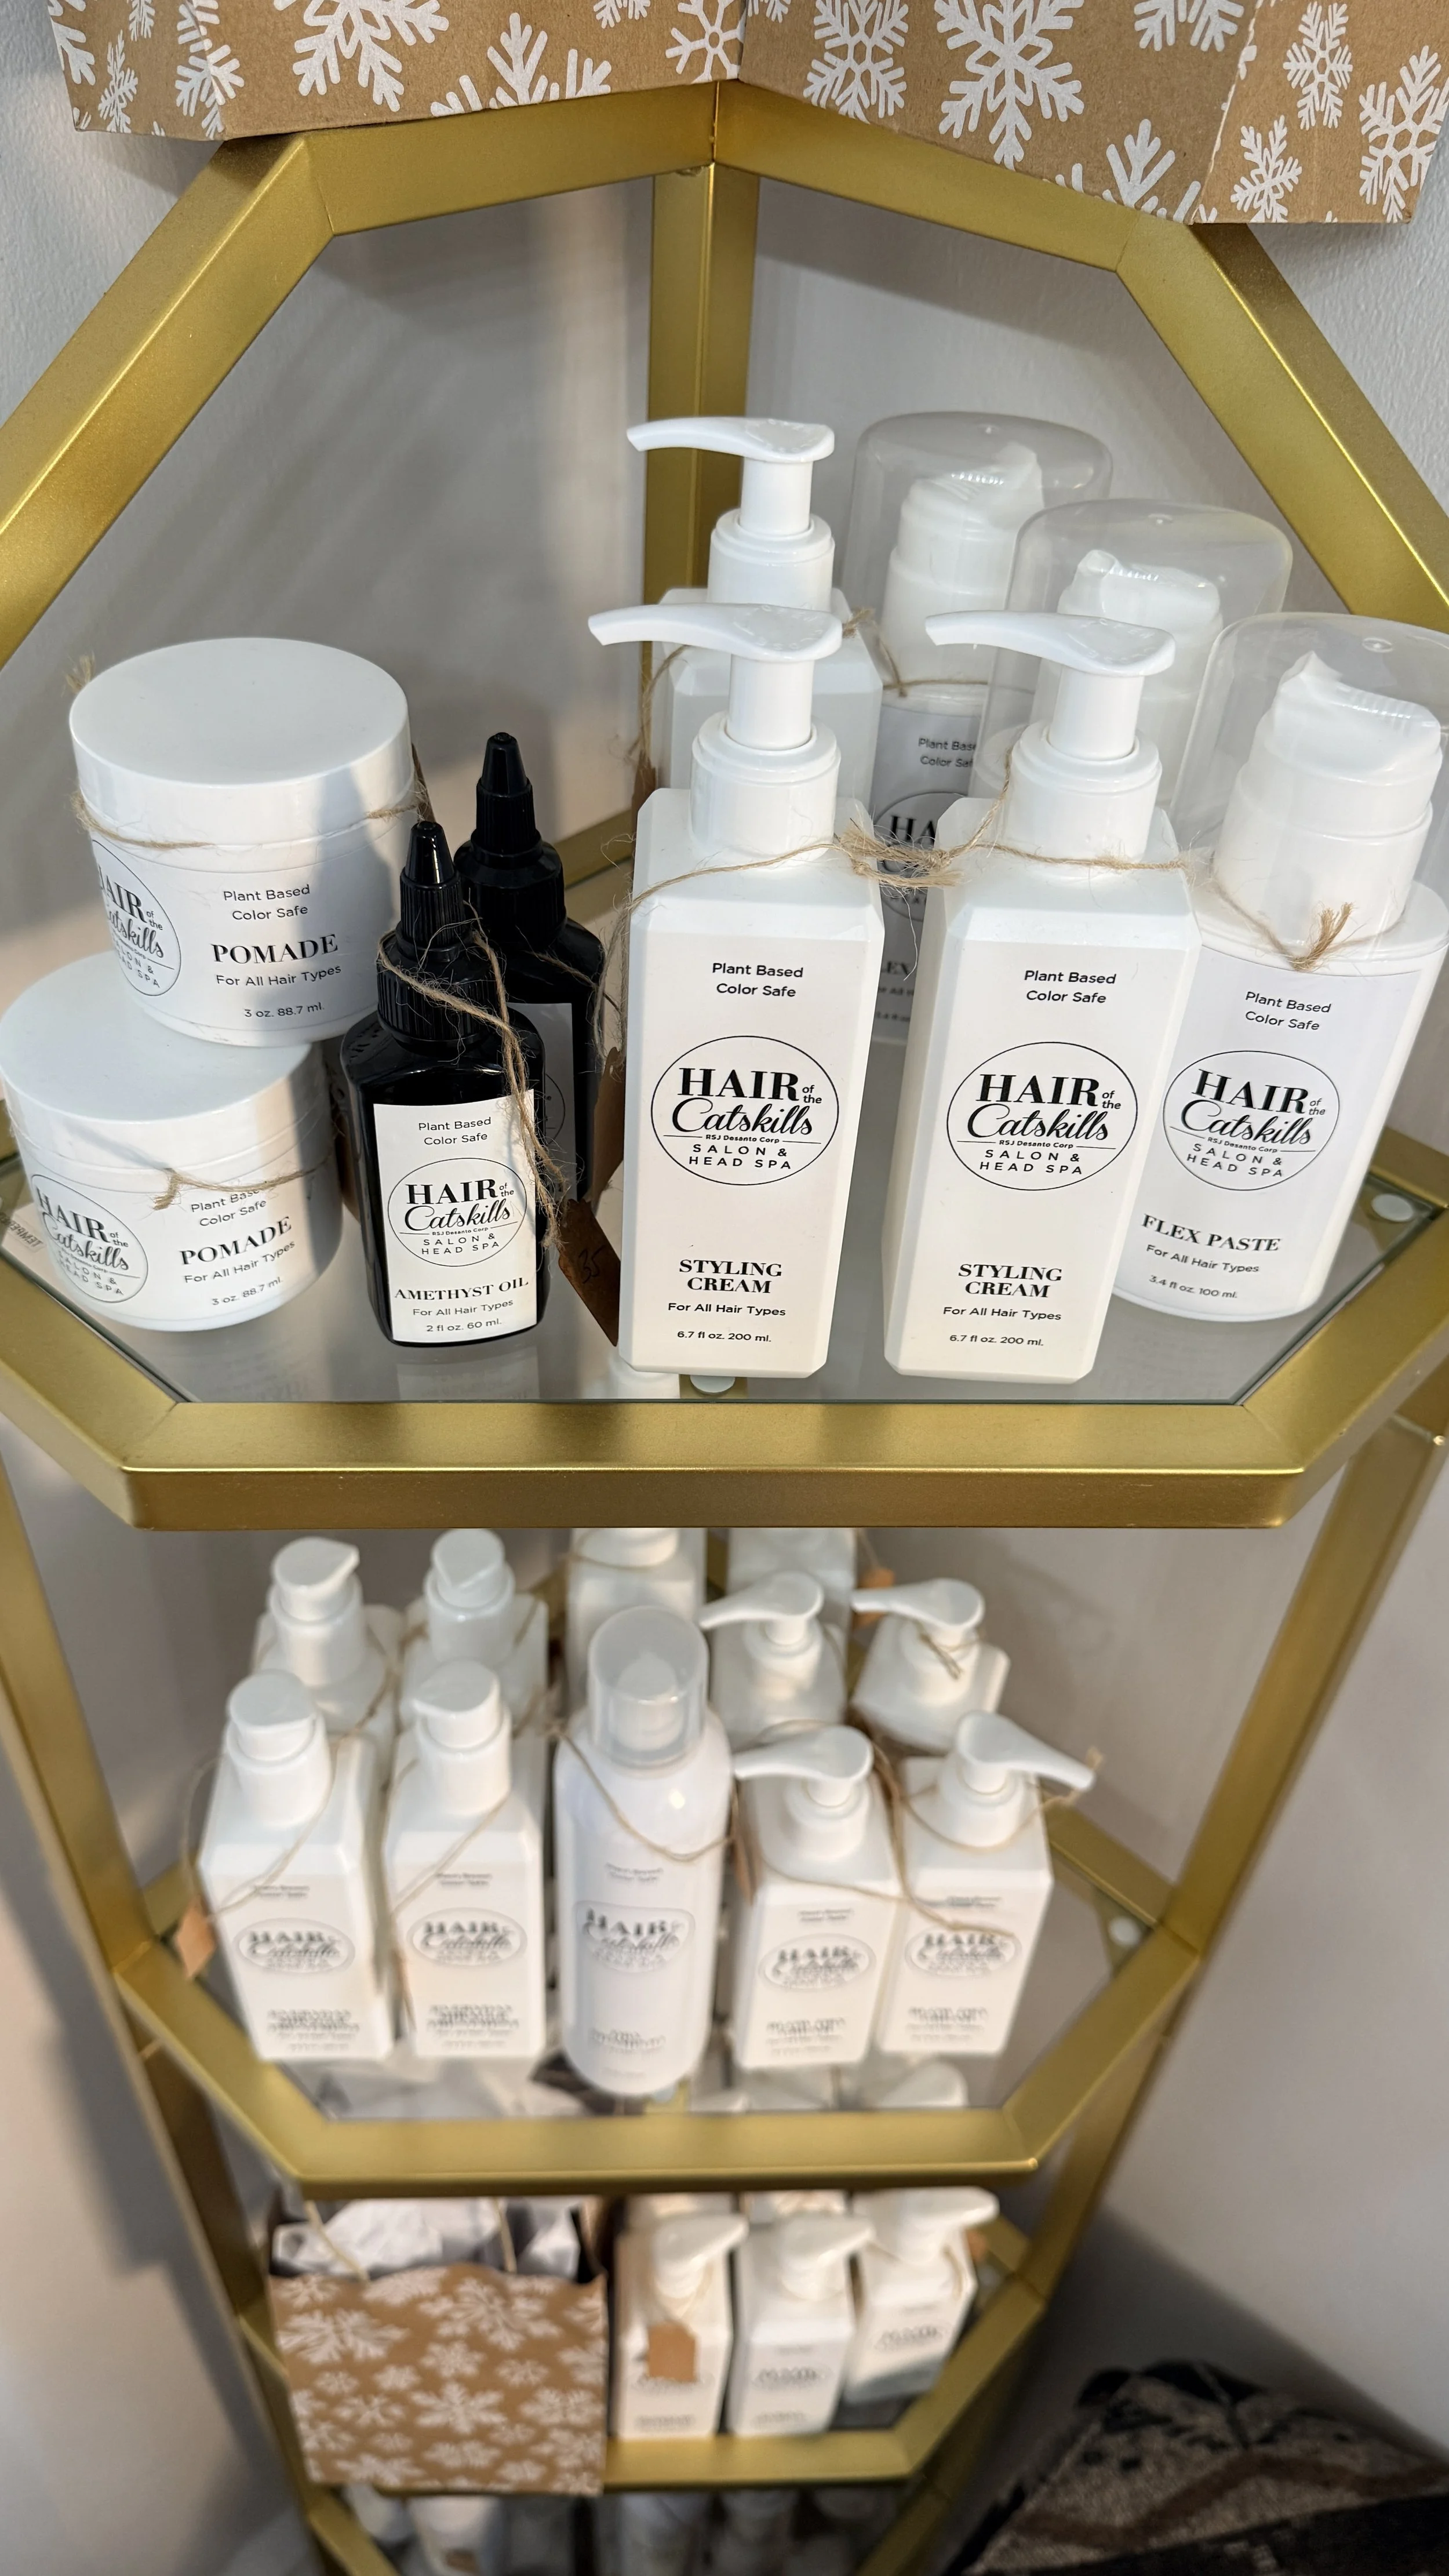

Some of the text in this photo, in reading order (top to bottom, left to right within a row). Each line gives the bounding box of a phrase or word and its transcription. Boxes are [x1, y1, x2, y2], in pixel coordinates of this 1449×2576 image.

[918, 737, 948, 750] Plant
[919, 755, 974, 767] Color Saf
[890, 815, 936, 845] HA
[223, 883, 311, 901] Plant Based
[146, 910, 155, 919] of
[232, 905, 309, 920] Color Safe
[148, 919, 163, 931] the
[108, 910, 165, 958] atskills
[210, 933, 338, 965] POMADE
[147, 965, 155, 975] &
[216, 965, 342, 987] For All Hair Types
[712, 962, 804, 978] Plant Based
[1024, 970, 1116, 985] Plant Based
[137, 969, 161, 989] SPA
[716, 983, 796, 998] Color Safe
[1026, 990, 1107, 1004] Color Safe
[243, 1002, 325, 1018] 3 oz. 88.7 ml.
[1245, 991, 1332, 1013] Plant Based
[1245, 1010, 1320, 1031] Color Safe
[677, 1067, 822, 1105] HAIR of the
[975, 1074, 1122, 1110] HAIR of the
[1190, 1068, 1326, 1116] HAIR of the
[418, 1116, 492, 1131] Plant Based
[671, 1097, 813, 1136] Catskills
[967, 1103, 1108, 1141] Catskills
[1180, 1099, 1313, 1145] Catskills
[423, 1133, 488, 1145] Color Safe
[723, 1134, 758, 1143] Desanto
[1017, 1140, 1051, 1148] Desanto
[1207, 1136, 1223, 1145] RSJ
[1224, 1140, 1257, 1151] Desanto
[692, 1143, 787, 1157] SALON &
[984, 1149, 1080, 1162] SALON &
[1192, 1143, 1282, 1166] SALON &
[689, 1156, 792, 1170] HEAD SPA
[980, 1161, 1083, 1174] HEAD SPA
[1186, 1153, 1283, 1177] HEAD SPA
[405, 1178, 515, 1205] HAIR of the
[190, 1198, 227, 1213] Plant
[199, 1199, 267, 1227] Color Safe
[36, 1186, 111, 1243] HAIR
[112, 1239, 129, 1247] the
[405, 1198, 511, 1231] Catskills
[42, 1211, 129, 1271] Catskills
[179, 1216, 292, 1265] POMADE
[423, 1235, 480, 1246] SALON
[1140, 1213, 1283, 1252] FLEX PASTE
[421, 1242, 500, 1255] HEAD SPA
[184, 1240, 296, 1283] For All Hair Types
[1145, 1244, 1259, 1273] For All Hair Types
[679, 1259, 782, 1277] STYLING
[957, 1264, 1062, 1282] STYLING
[96, 1282, 125, 1296] SPA
[109, 1277, 117, 1285] &
[394, 1277, 529, 1301] AMETHYST OIL
[686, 1277, 773, 1294] CREAM
[964, 1281, 1051, 1298] CREAM
[1148, 1274, 1238, 1298] 3.4 fl oz. 100 ml.
[211, 1276, 284, 1306] 3 oz. 88.7 ml.
[454, 1306, 478, 1315] Hair
[480, 1300, 514, 1312] Types
[668, 1302, 786, 1316] For All Hair Types
[942, 1307, 1062, 1320] For All Hair Types
[467, 1321, 483, 1330] 60
[486, 1318, 502, 1327] ml.
[697, 1331, 705, 1339] fl
[755, 1334, 772, 1342] ml.
[949, 1334, 967, 1342] 6.7
[969, 1334, 978, 1342] fl
[999, 1336, 1024, 1345] 200
